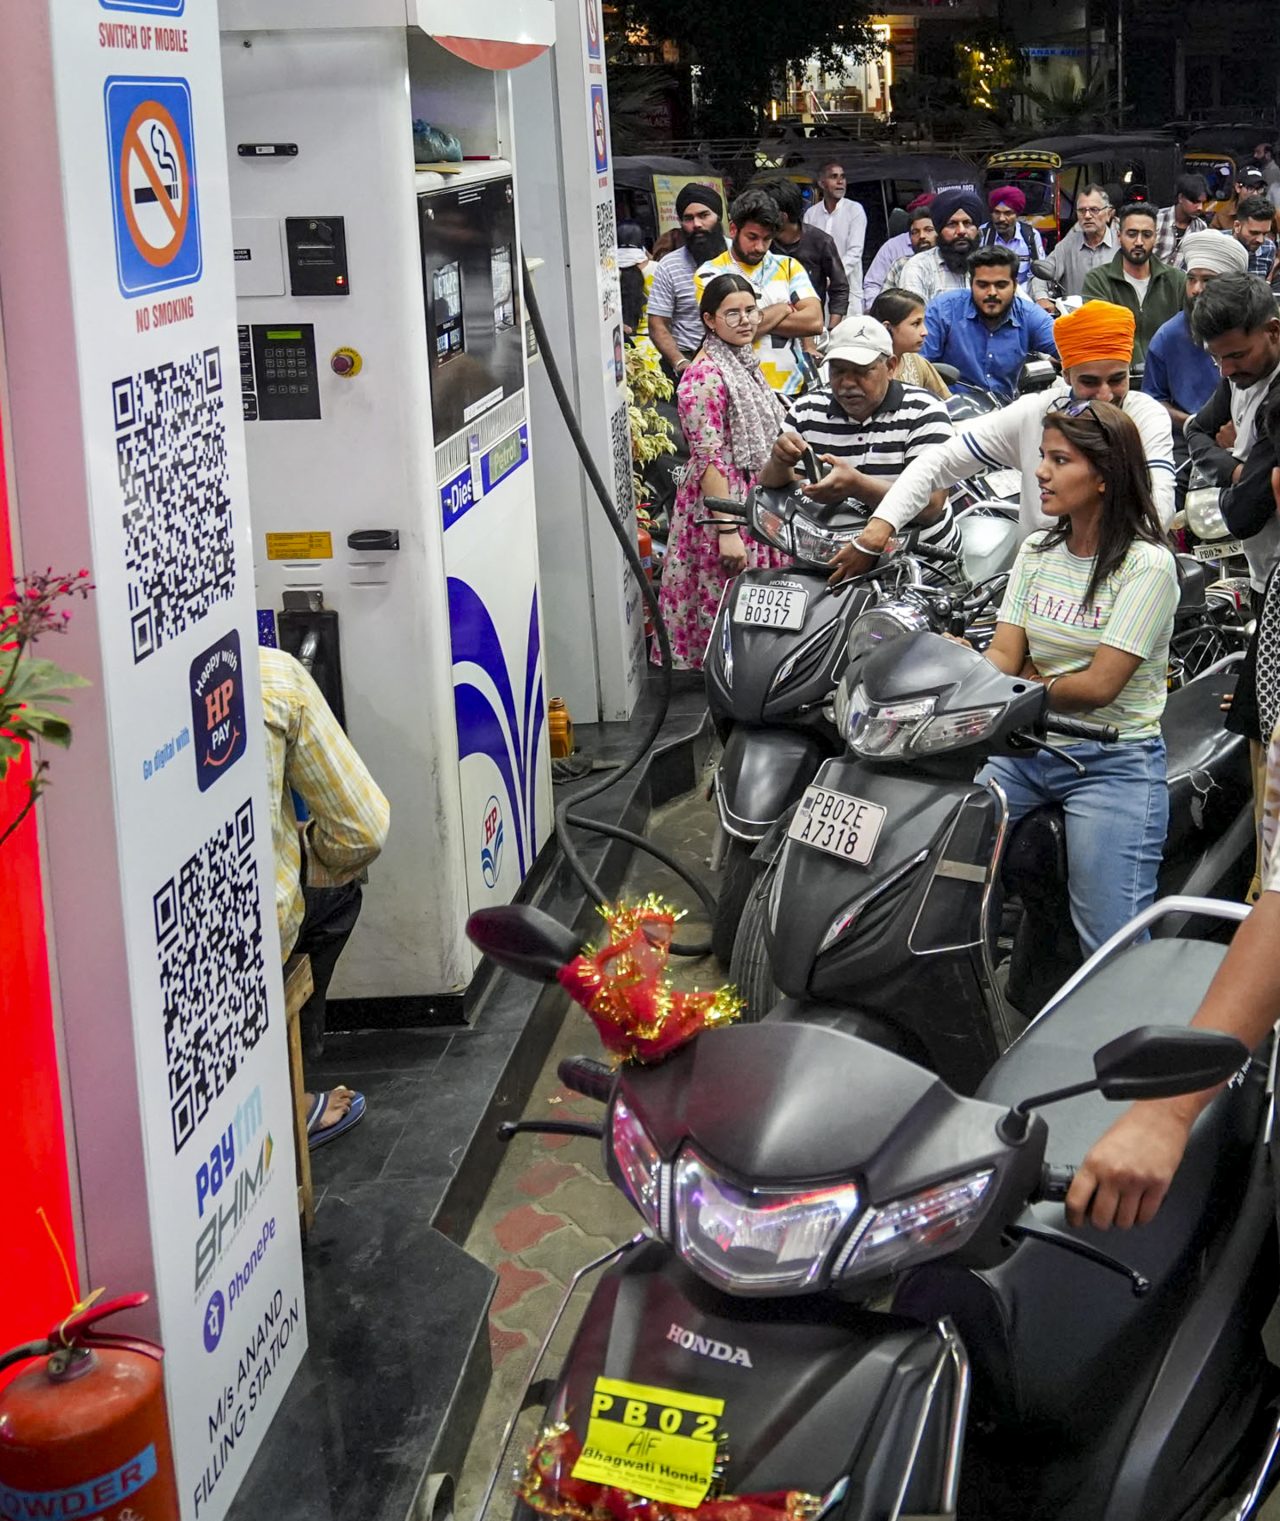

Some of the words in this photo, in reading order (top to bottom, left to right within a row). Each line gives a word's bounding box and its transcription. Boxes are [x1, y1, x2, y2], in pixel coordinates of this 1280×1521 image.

[99, 22, 138, 49] SWITCH
[140, 26, 152, 50] OF
[154, 27, 188, 52] MOBILE
[136, 307, 149, 333] NO
[152, 295, 194, 328] SMOKING
[493, 438, 518, 473] Petrol
[451, 479, 472, 514] Dies
[748, 588, 793, 608] PB02E
[769, 580, 803, 590] HONDA
[744, 605, 790, 625] B0317
[1028, 592, 1103, 630] AMIRI
[195, 650, 221, 697] Happy
[221, 649, 239, 672] with
[205, 679, 234, 731] HP
[211, 720, 231, 750] PAY
[484, 806, 498, 846] HP
[811, 792, 869, 829] PB02E
[800, 818, 858, 855] A7318
[195, 1139, 265, 1293] BHIM
[228, 1216, 276, 1312] PhonePe
[666, 1323, 753, 1369] HONDA
[208, 1386, 234, 1443] M/s
[237, 1289, 284, 1393] ANAND
[193, 1404, 247, 1519] FILLING
[248, 1298, 299, 1412] STATION
[583, 1447, 655, 1474] Bhagwati
[659, 1464, 709, 1486] Honda
